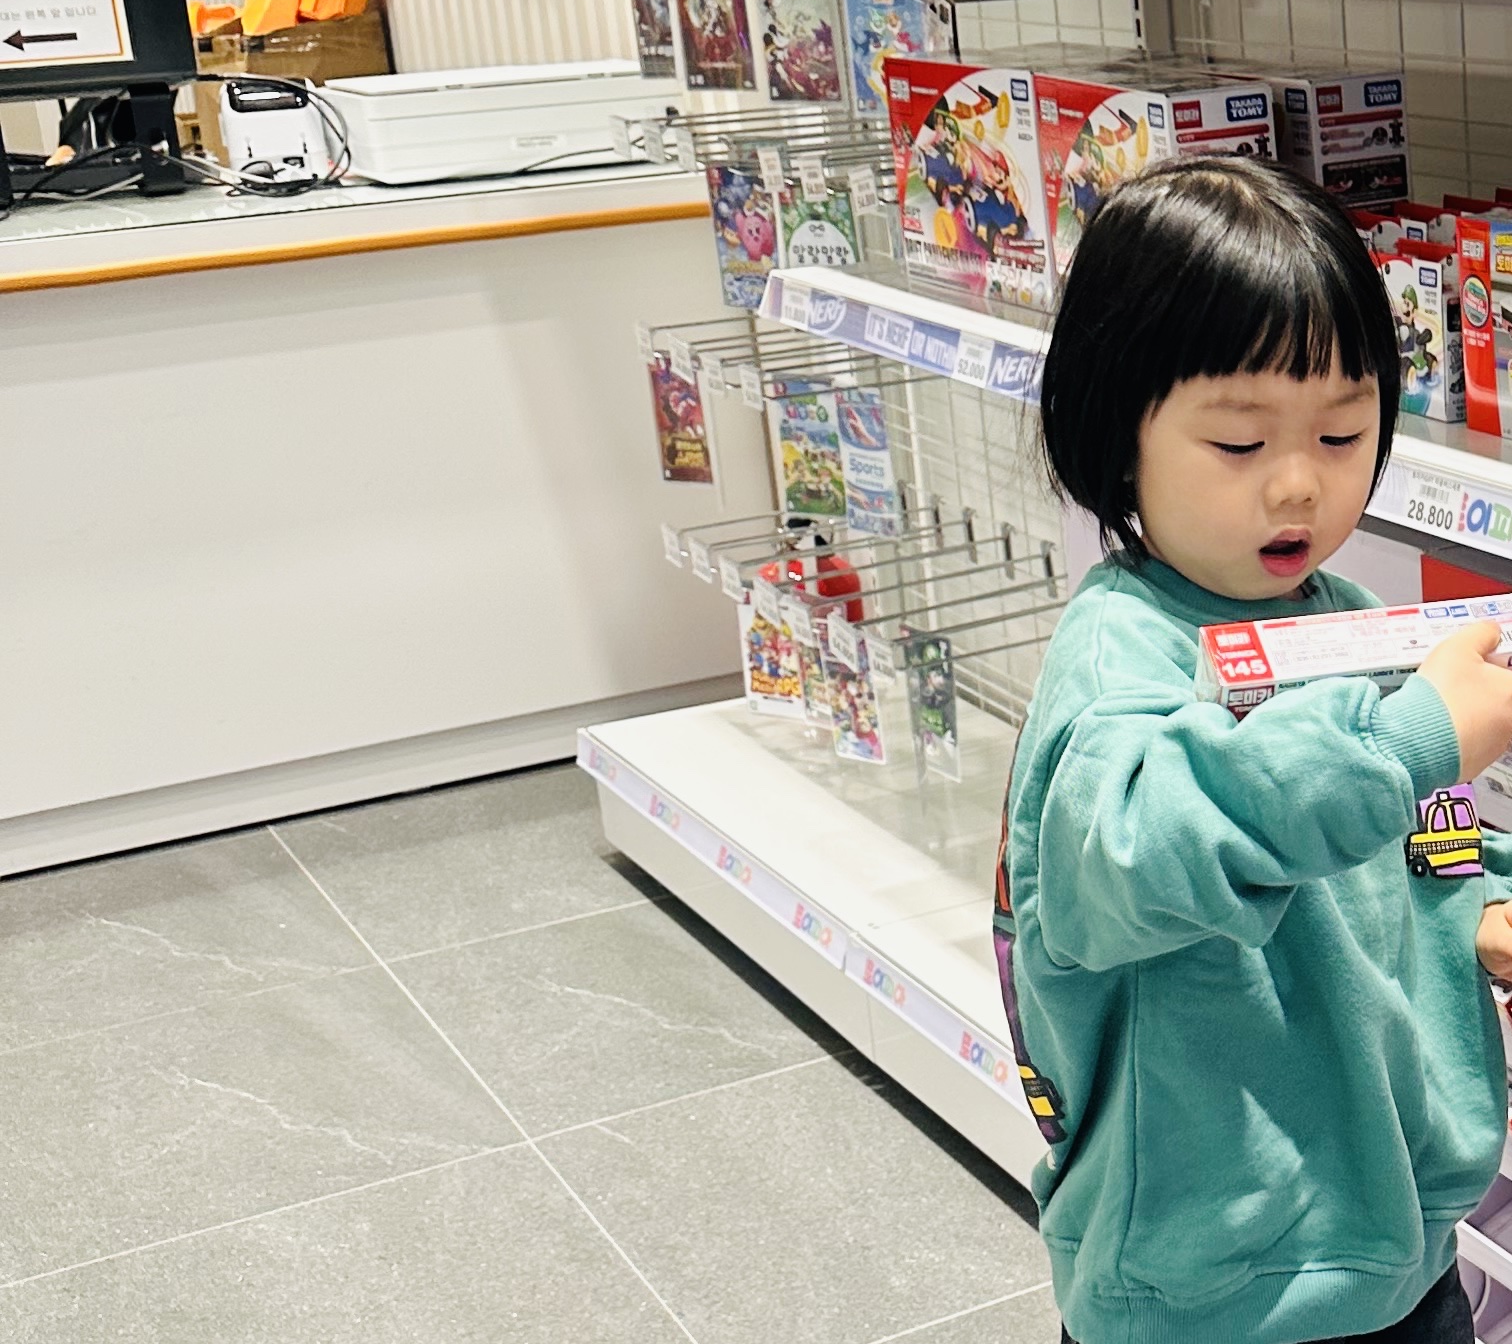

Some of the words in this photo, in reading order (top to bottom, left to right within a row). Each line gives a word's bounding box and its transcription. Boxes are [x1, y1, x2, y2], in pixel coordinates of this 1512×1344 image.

[1229, 97, 1264, 110] TAKARA
[1230, 107, 1265, 119] TOMY
[1407, 499, 1454, 531] 28,800
[1222, 658, 1267, 679] 145
[958, 1030, 1008, 1086] 토이피아
